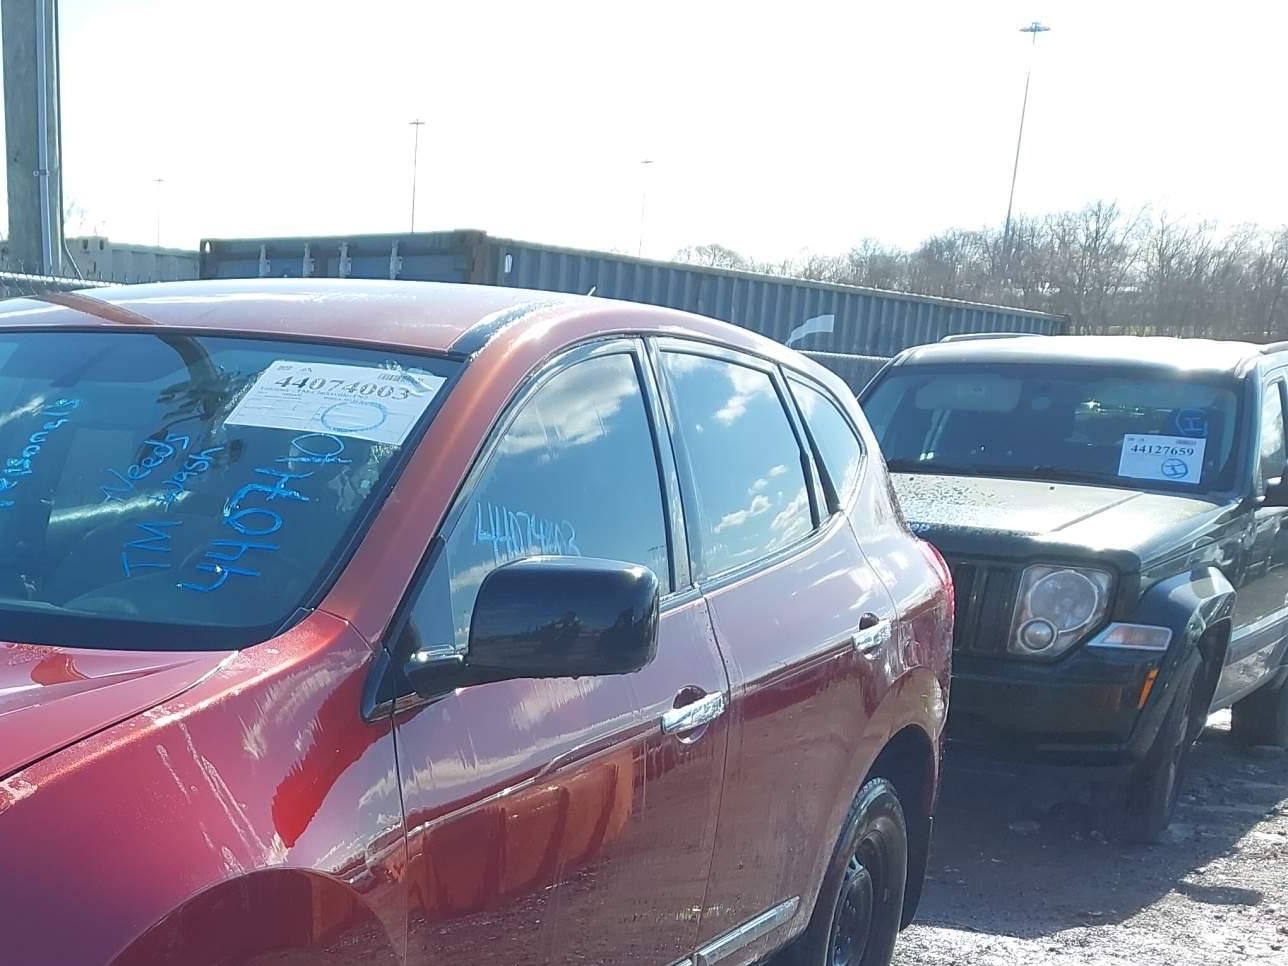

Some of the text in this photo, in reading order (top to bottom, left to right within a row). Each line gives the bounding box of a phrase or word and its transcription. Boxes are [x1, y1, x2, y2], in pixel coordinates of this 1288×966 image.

[274, 375, 410, 401] 44074003
[1130, 443, 1195, 457] 44127659
[121, 519, 183, 577] TM
